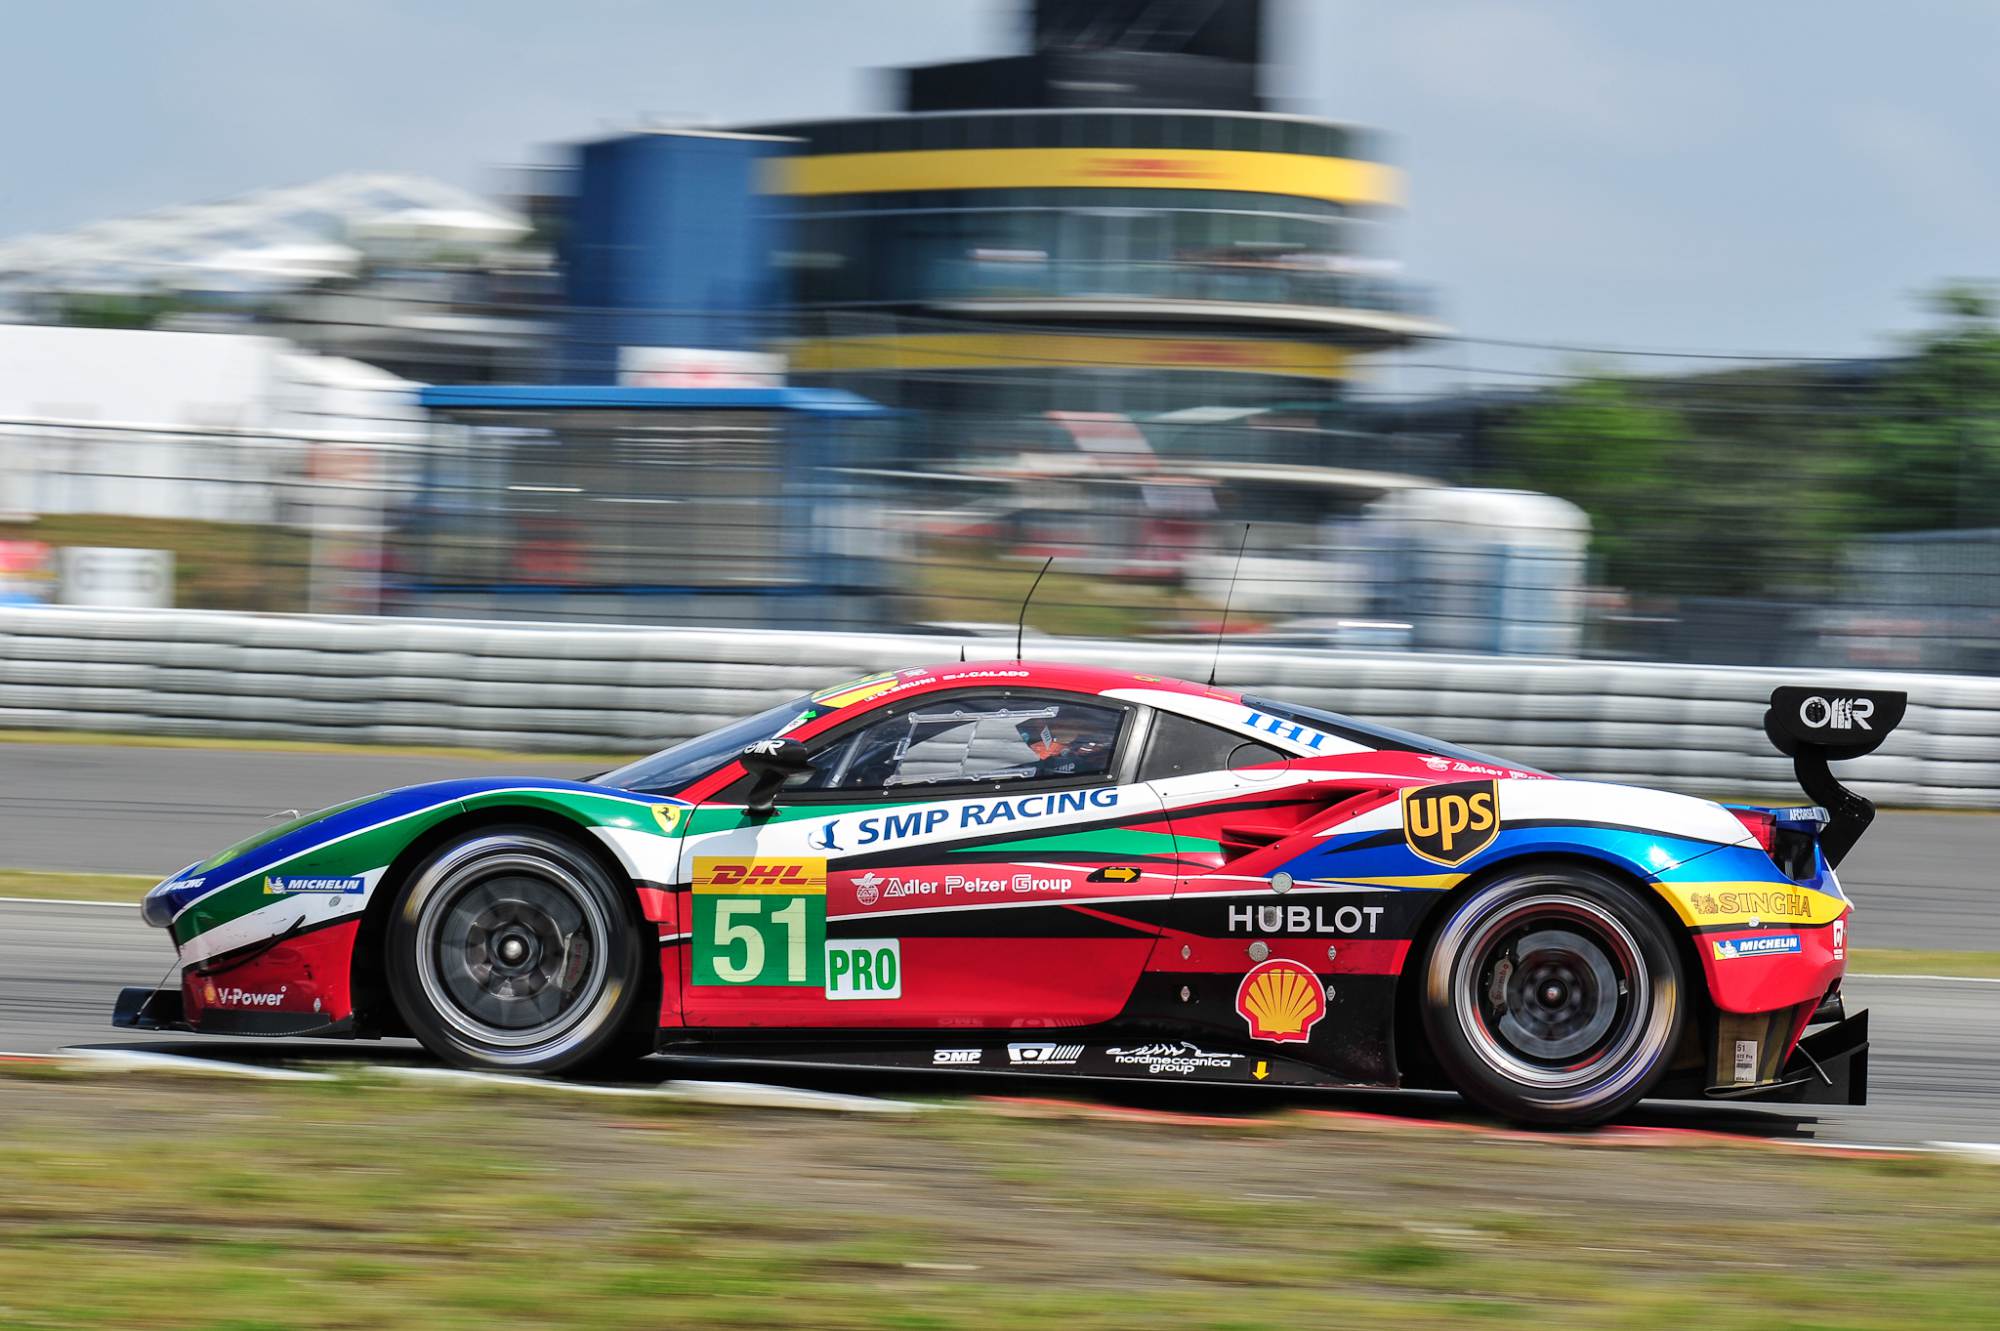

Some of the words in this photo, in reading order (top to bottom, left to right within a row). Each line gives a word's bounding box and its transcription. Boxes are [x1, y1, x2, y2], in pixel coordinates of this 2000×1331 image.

[1244, 712, 1327, 750] IHI
[857, 809, 949, 845] SMP
[959, 787, 1119, 828] RACING
[288, 879, 360, 890] MICHELIN
[711, 865, 809, 885] DHL
[883, 877, 938, 898] Adler
[945, 875, 1008, 895] Pelzer
[1011, 874, 1072, 894] Group
[1719, 891, 1812, 917] SINGHA
[1228, 905, 1384, 933] HUBLOT
[712, 898, 807, 984] 51
[1739, 938, 1798, 952] MICHELIN
[829, 947, 897, 991] PRO
[218, 987, 284, 1006] V-Power
[933, 1052, 981, 1062] OMP
[1115, 1053, 1231, 1067] nordmeccanica
[1150, 1063, 1195, 1075] group
